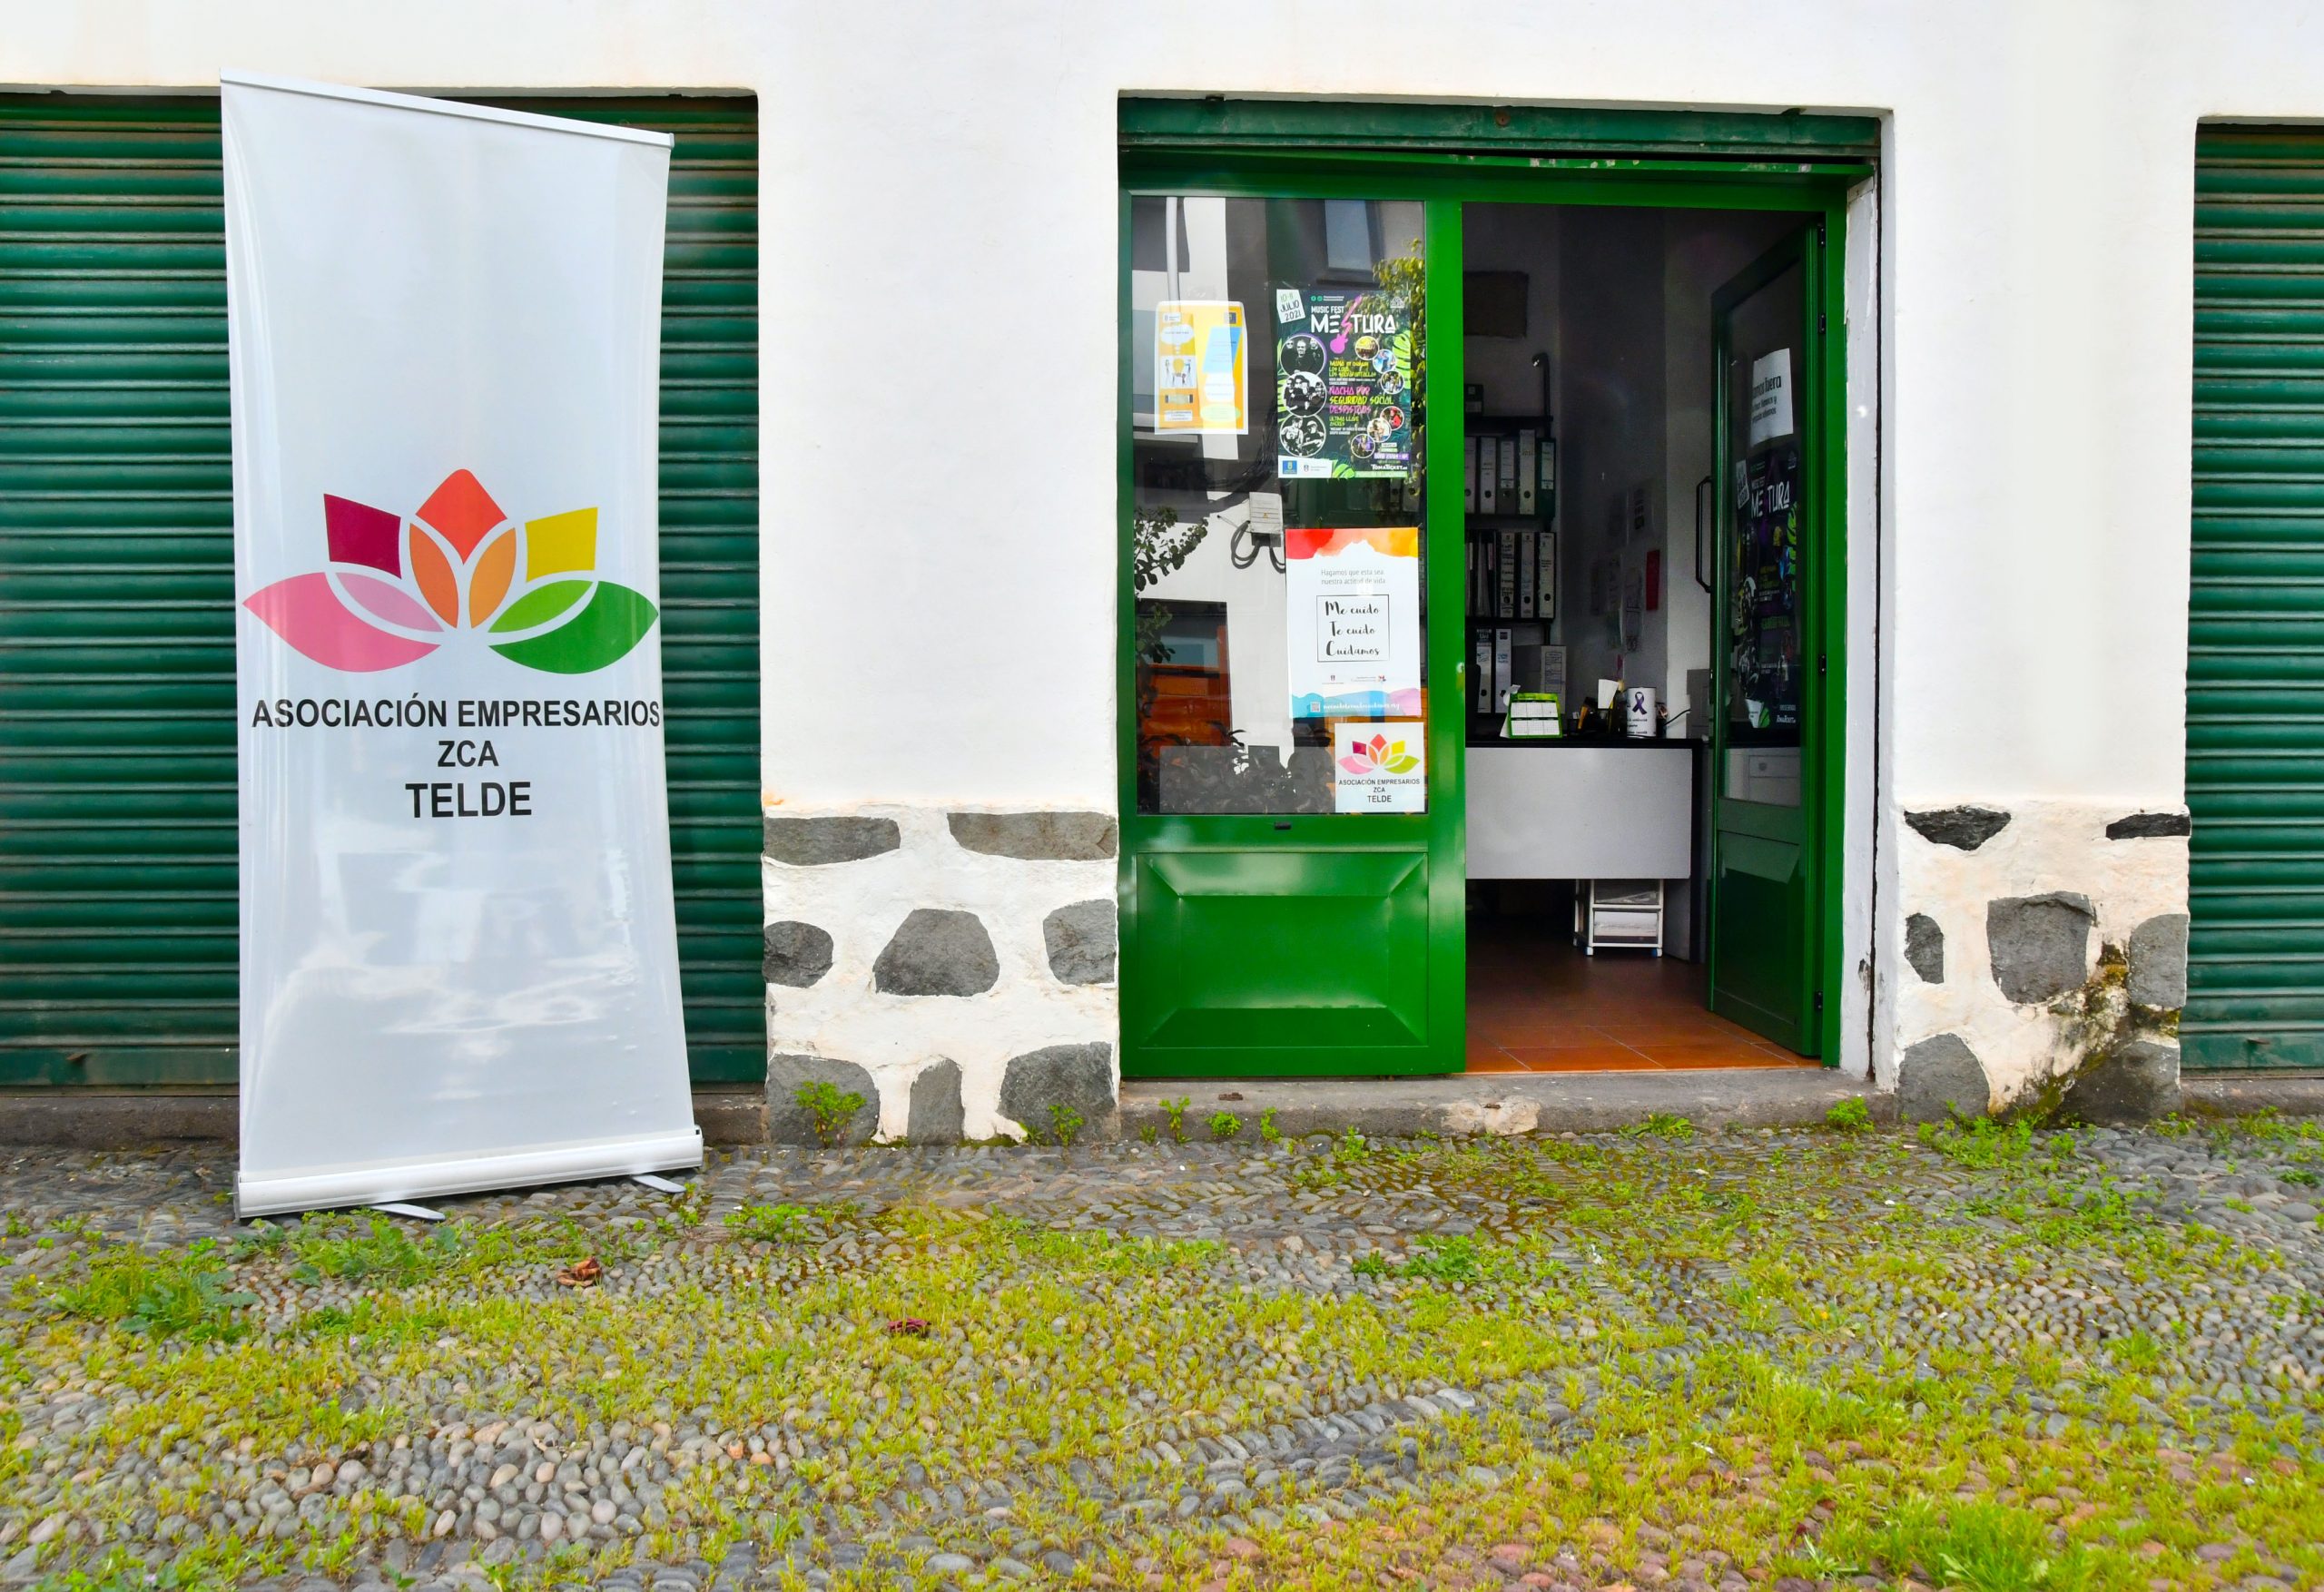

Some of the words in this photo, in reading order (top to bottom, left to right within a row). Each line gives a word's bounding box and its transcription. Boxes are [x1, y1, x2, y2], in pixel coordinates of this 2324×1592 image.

[1281, 300, 1300, 313] JULIO
[1285, 310, 1302, 321] 2021
[1329, 396, 1367, 405] SEGURIDAD
[1369, 395, 1393, 405] SOCIAL
[1325, 601, 1347, 616] Me
[1350, 604, 1381, 614] cuido
[1329, 621, 1344, 636] Te
[1346, 624, 1376, 634] cuido
[1326, 640, 1381, 656] Cuidamos
[252, 692, 448, 728] ASOCIACIÓN
[458, 699, 661, 727] EMPRESARIOS
[437, 740, 500, 768] ZCA
[405, 781, 533, 819] TELDE
[1367, 795, 1392, 803] TELDE
